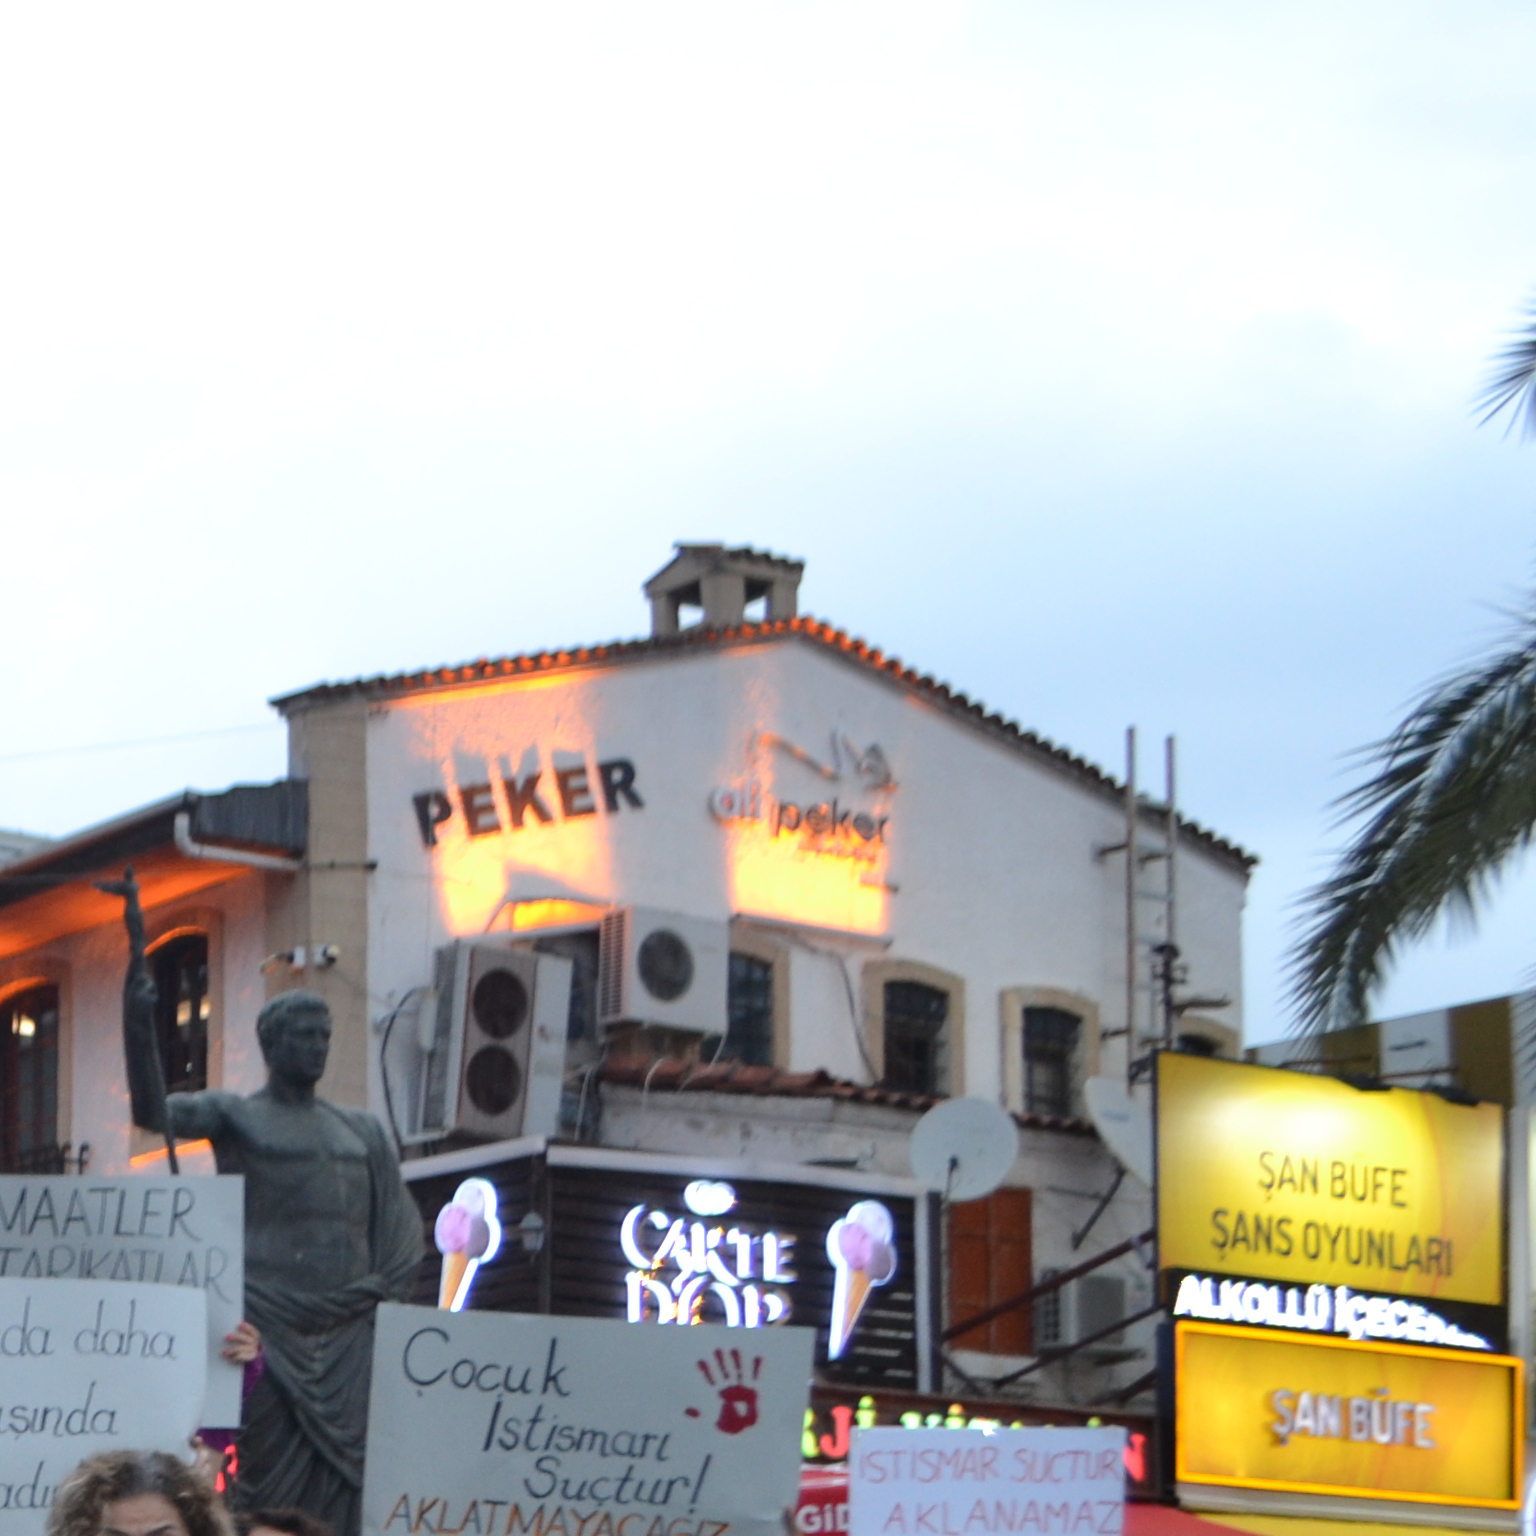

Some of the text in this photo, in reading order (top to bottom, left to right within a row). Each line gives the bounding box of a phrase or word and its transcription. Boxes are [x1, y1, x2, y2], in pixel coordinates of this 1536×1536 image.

[412, 758, 644, 849] PEKER
[773, 798, 889, 842] peker
[1212, 1209, 1453, 1278] ŞANS OYUNLARI
[74, 1298, 178, 1360] daha
[1174, 1275, 1329, 1331] ALKOLLÜ
[1270, 1388, 1436, 1448] ŞAN BÜFE
[523, 1453, 713, 1514] Suçtur!
[883, 1498, 1123, 1536] AKLANAMAZ
